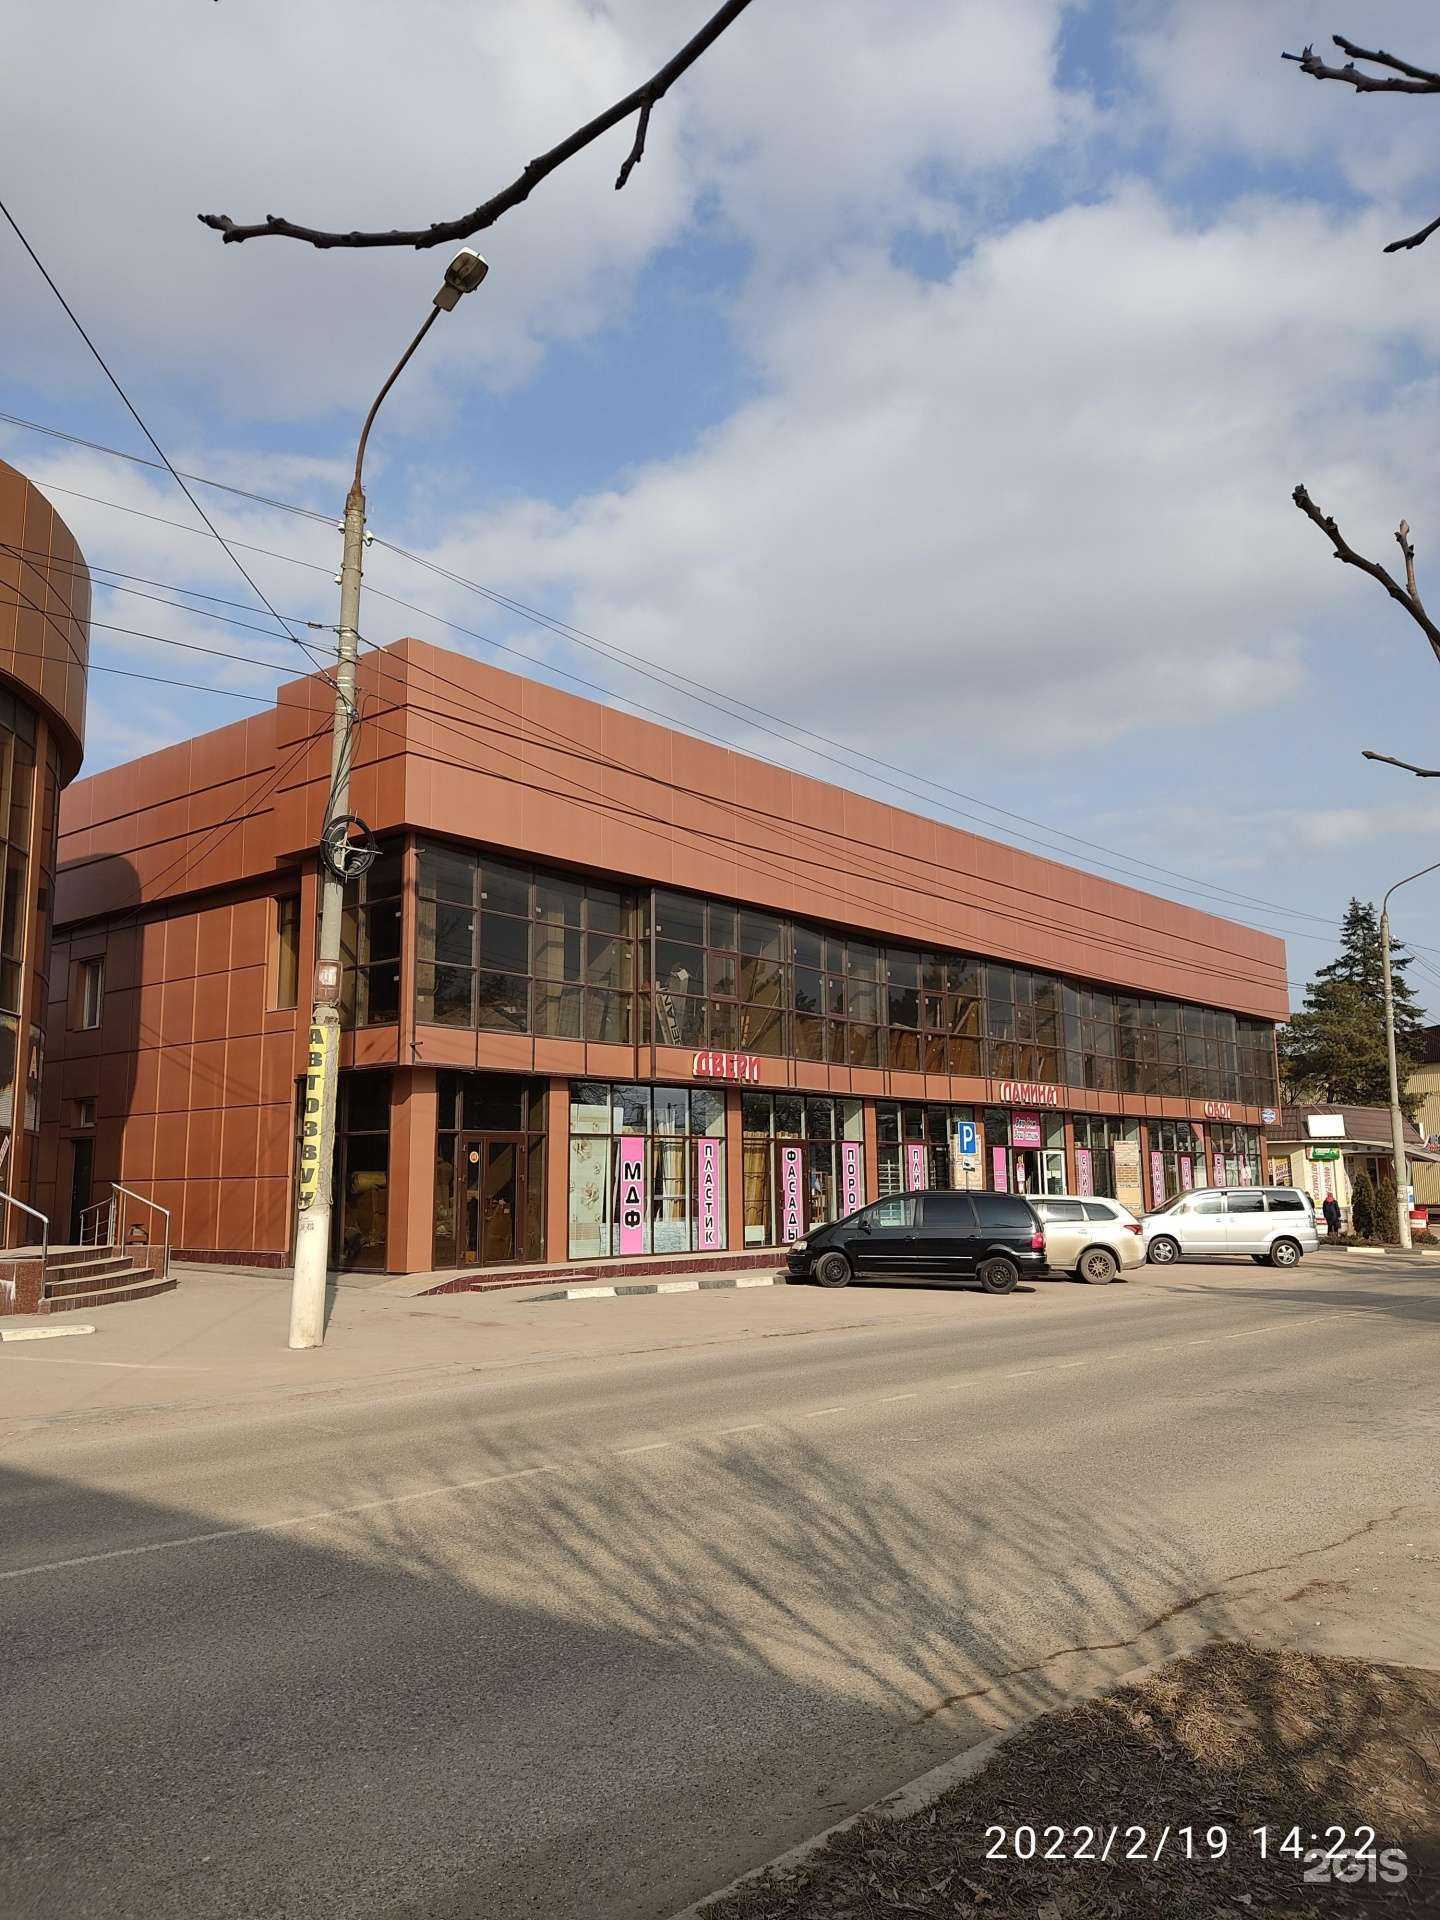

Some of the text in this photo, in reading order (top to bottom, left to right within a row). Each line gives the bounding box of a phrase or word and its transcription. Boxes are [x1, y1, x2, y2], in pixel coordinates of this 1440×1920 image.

[693, 1051, 761, 1082] ДВЕРИ
[299, 1028, 324, 1208] АВТОЗВУК
[962, 1125, 974, 1151] P
[1204, 1101, 1232, 1119] ОБОИ
[624, 1161, 641, 1229] МДФ
[704, 1144, 714, 1243] ПЛАСТИК
[786, 1150, 798, 1241] ФАСАДЫ
